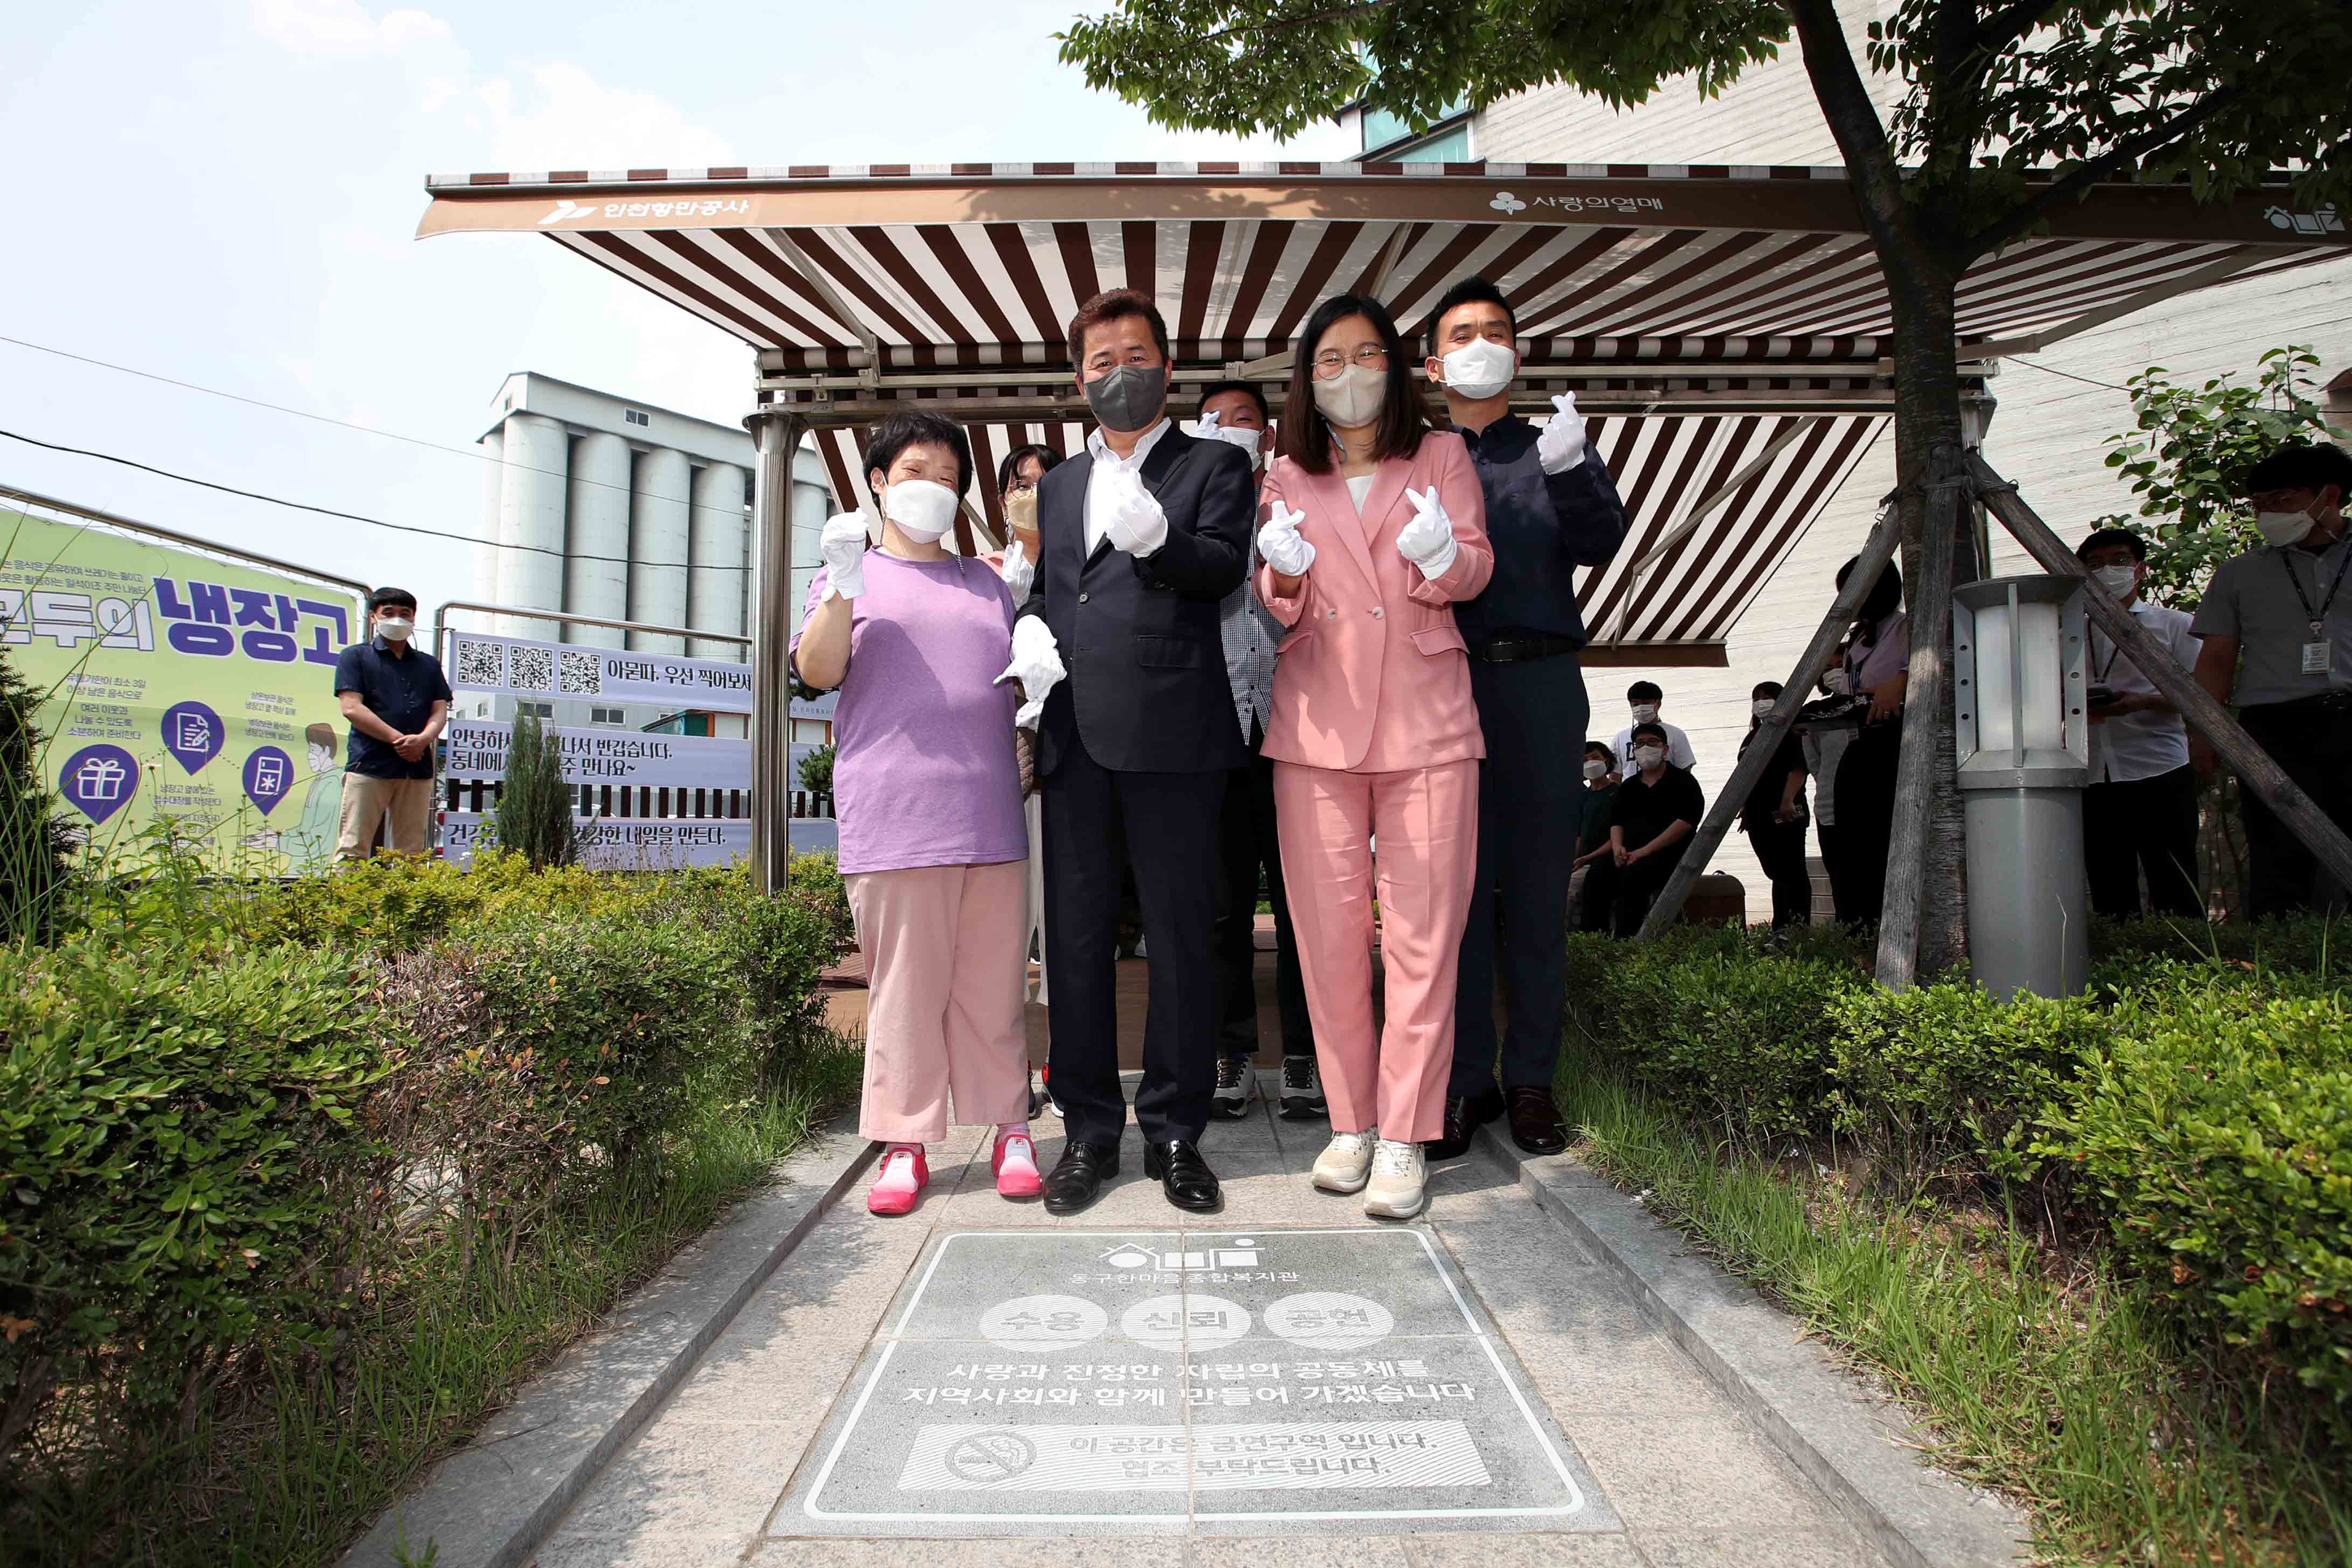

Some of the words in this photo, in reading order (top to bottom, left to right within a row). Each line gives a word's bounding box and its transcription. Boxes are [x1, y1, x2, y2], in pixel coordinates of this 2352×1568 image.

[604, 199, 750, 218] 인천항만공사
[1532, 195, 1663, 213] 사랑의열매
[15, 559, 44, 571] 음식은
[0, 573, 22, 584] 웃은
[153, 578, 348, 667] 냉장고
[114, 677, 130, 687] 최소
[132, 680, 146, 688] 3일
[608, 660, 660, 682] 아묻따.
[664, 666, 694, 686] 우선
[108, 689, 142, 699] 음식으로
[81, 703, 100, 713] 여러
[102, 705, 128, 715] 이웃과
[96, 717, 104, 725] 수
[106, 717, 133, 727] 있도록
[68, 727, 104, 737] 소분하여
[107, 729, 142, 740] 준비한다
[562, 737, 591, 755] 나서
[597, 739, 673, 759] 반갑습니다.
[451, 750, 508, 772] 동네에
[582, 758, 636, 776] 만나요~
[627, 826, 673, 845] 내일을
[679, 827, 726, 845] 만든다.
[1071, 1271, 1300, 1284] 동구한마음종합복지관
[1000, 1312, 1085, 1331] 수용
[1142, 1311, 1228, 1331] 신뢰
[947, 1364, 1050, 1381] 사랑과
[1063, 1364, 1164, 1382] 진정한
[1176, 1362, 1280, 1381] 자립의
[1292, 1360, 1430, 1379] 공동체를
[904, 1387, 1084, 1406] 지역사회와
[1095, 1387, 1165, 1406] 함께
[1181, 1385, 1290, 1406] 만들어
[1301, 1383, 1476, 1404] 가겠습니다
[1070, 1437, 1097, 1453] 이
[1109, 1437, 1199, 1453] 공간은
[1211, 1433, 1329, 1452] 금연구역
[1337, 1432, 1438, 1451] 입니다.
[1121, 1460, 1180, 1478] 협조
[1197, 1456, 1392, 1475] 부탁드립니다.
